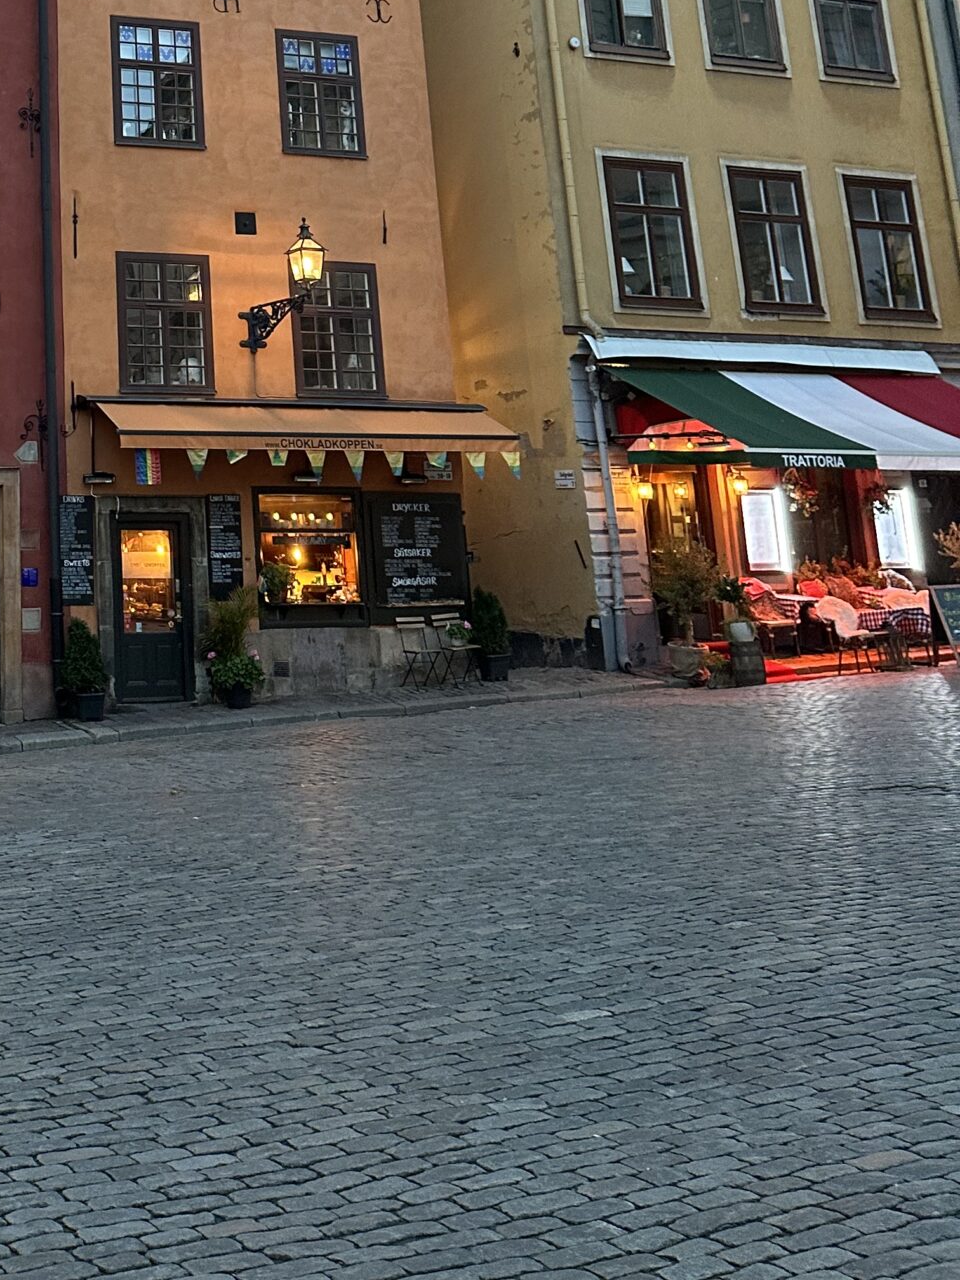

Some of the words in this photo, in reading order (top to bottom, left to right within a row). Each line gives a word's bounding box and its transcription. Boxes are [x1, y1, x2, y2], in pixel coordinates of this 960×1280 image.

[781, 455, 846, 468] TRATTORIA
[392, 504, 431, 512] DRYCKER
[64, 559, 90, 567] SWEETS
